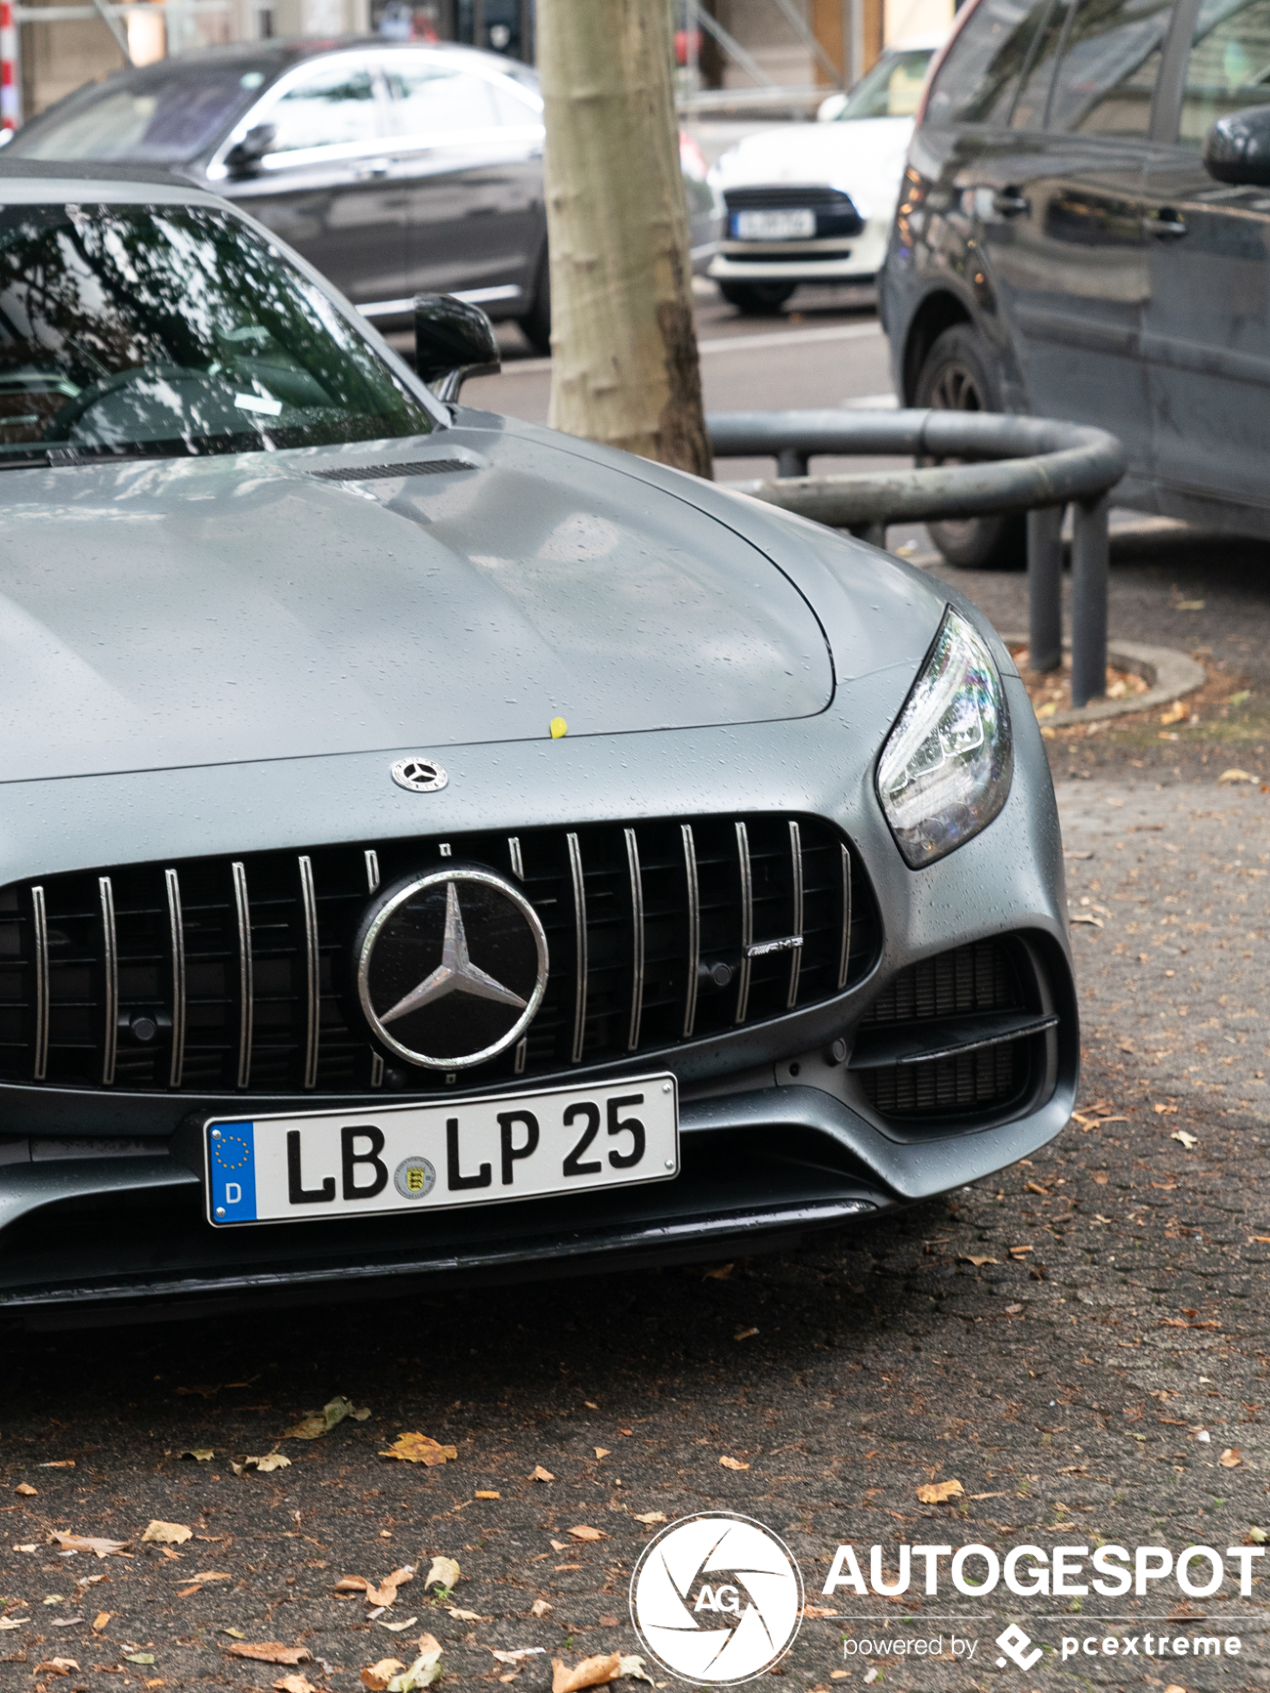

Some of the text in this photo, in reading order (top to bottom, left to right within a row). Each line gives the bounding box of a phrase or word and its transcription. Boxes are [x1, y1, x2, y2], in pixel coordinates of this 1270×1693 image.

[287, 1125, 389, 1205] LB
[446, 1110, 540, 1191] LP
[562, 1093, 646, 1177] 25
[225, 1182, 242, 1204] D
